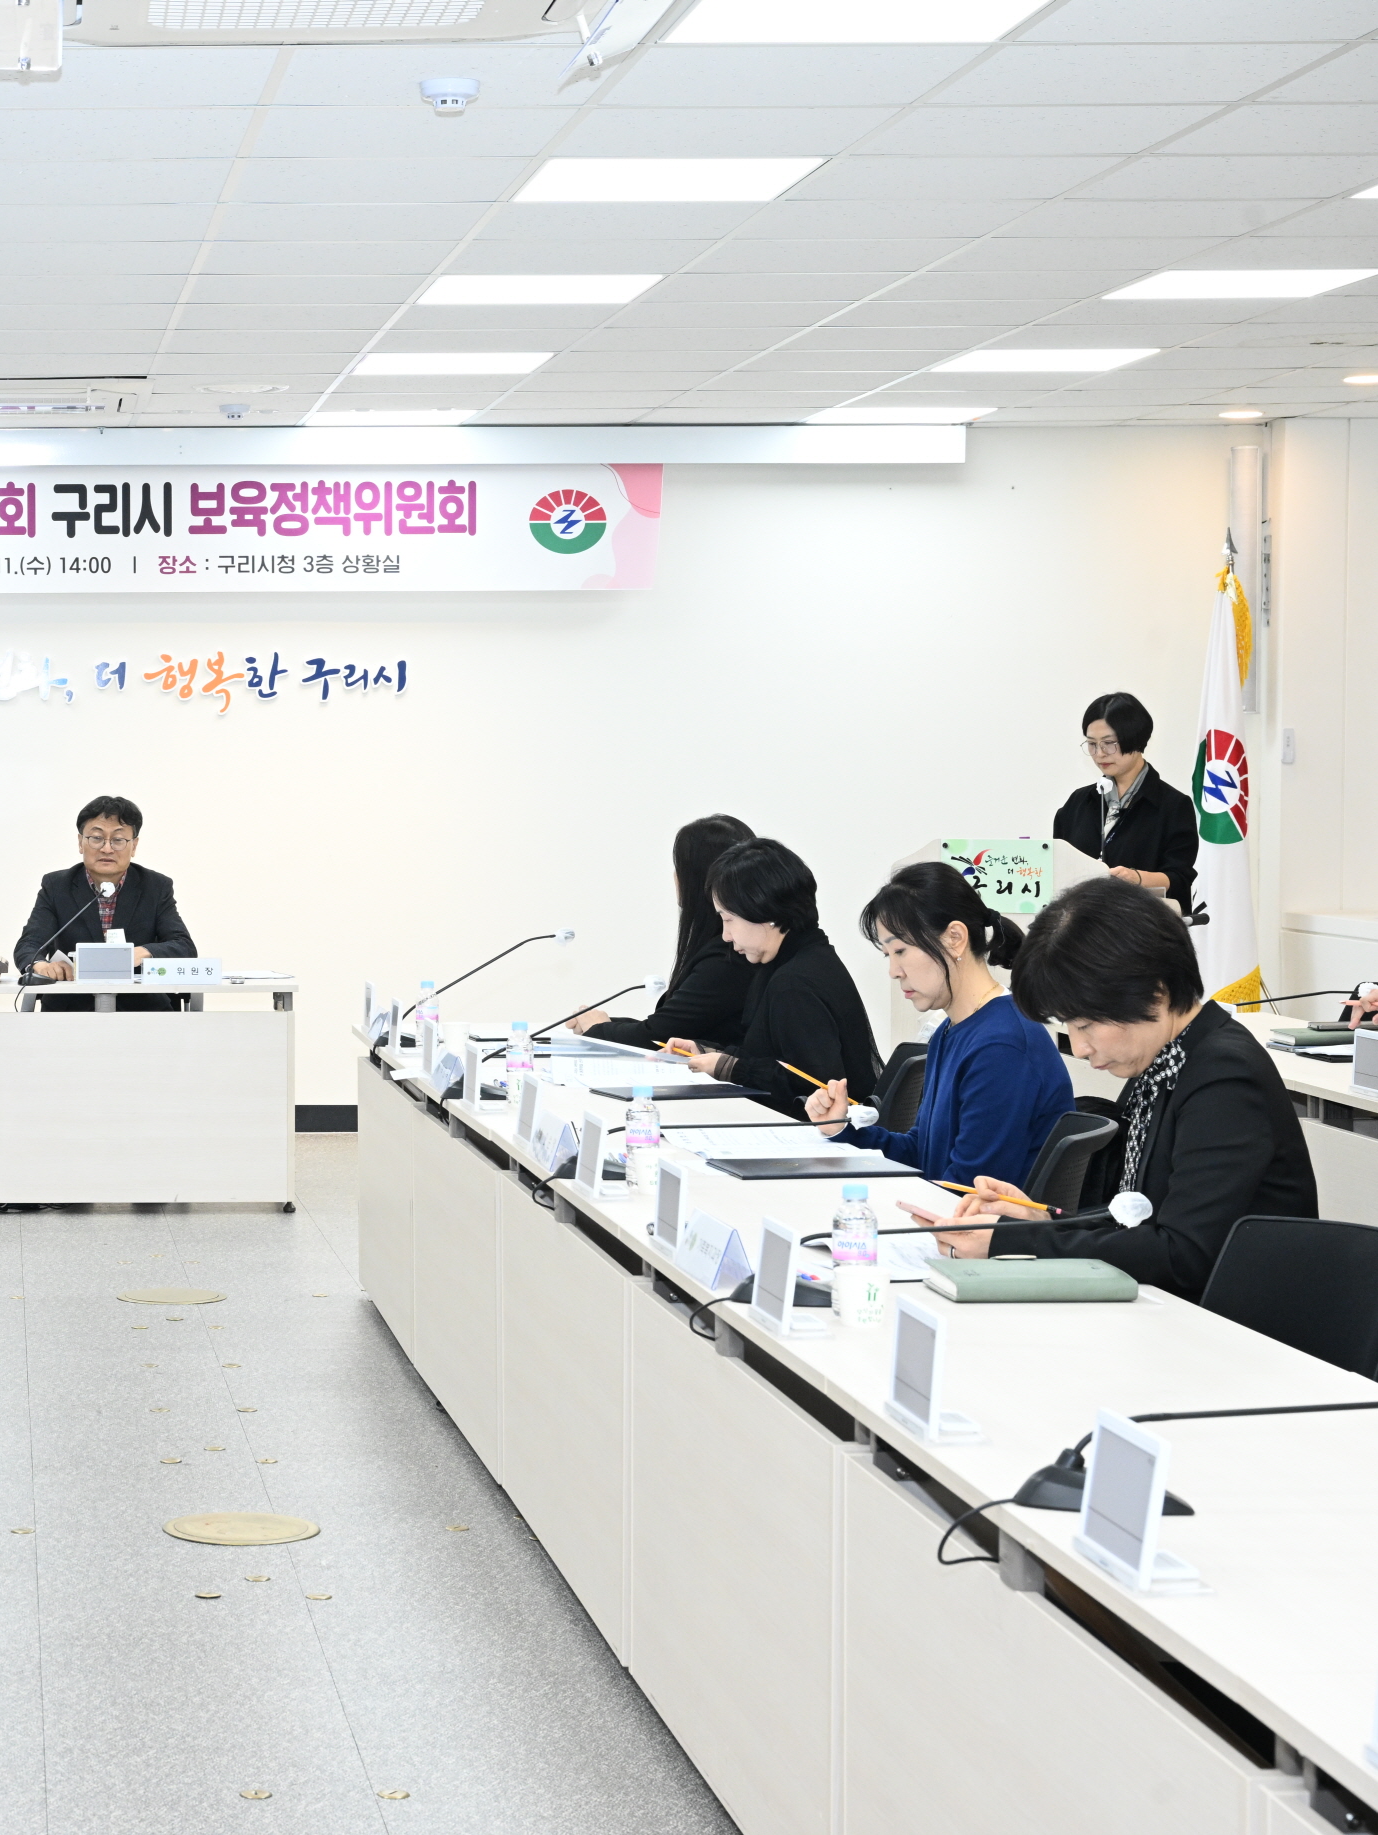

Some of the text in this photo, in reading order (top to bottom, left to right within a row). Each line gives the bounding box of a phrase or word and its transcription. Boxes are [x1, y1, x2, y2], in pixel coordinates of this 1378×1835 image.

[51, 482, 172, 538] 구리시
[187, 479, 477, 537] 보육정책위원회
[59, 557, 112, 574] 14:00
[157, 556, 197, 575] 장소
[217, 555, 296, 574] 구리시청
[303, 554, 335, 574] 3층
[341, 554, 401, 574] 상황실
[95, 661, 127, 691] 더
[143, 651, 289, 714] 행복한
[301, 657, 407, 701] 구리시
